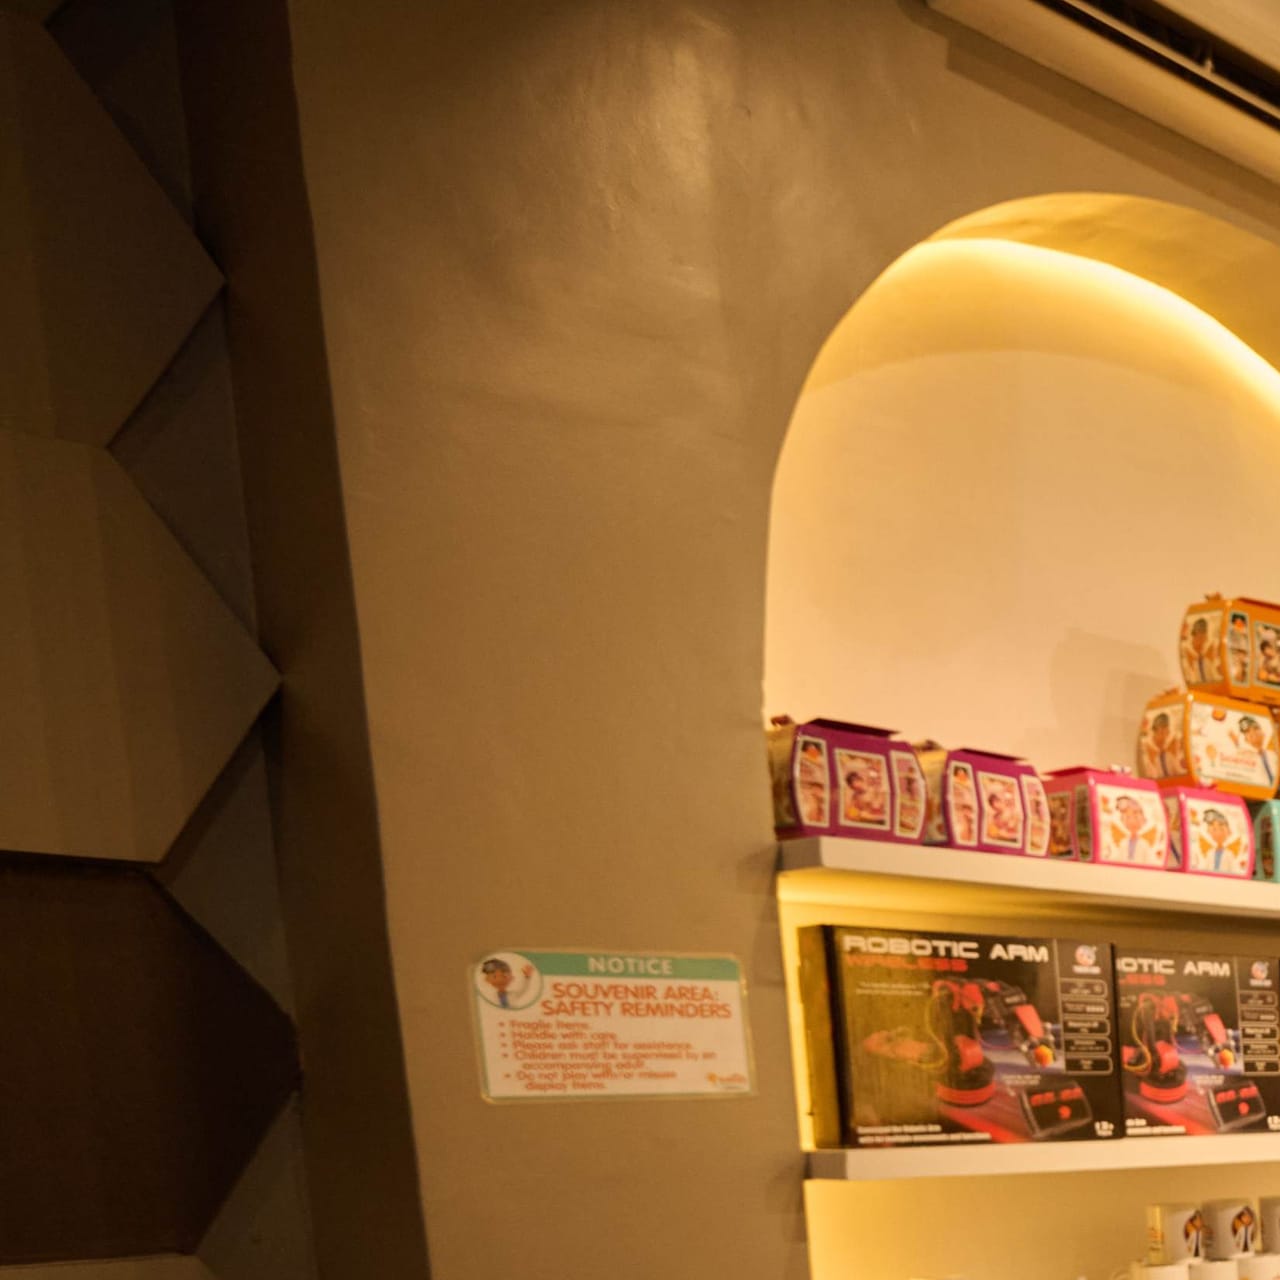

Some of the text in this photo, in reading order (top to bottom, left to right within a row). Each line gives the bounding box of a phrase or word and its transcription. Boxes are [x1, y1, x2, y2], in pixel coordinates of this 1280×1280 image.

[842, 935, 1049, 963] ROBOTIC ARM
[588, 957, 673, 975] NOTICE
[1183, 961, 1231, 977] ARM
[553, 982, 719, 1001] SOUVENIR AREA:
[542, 1001, 732, 1019] SAFETY REMINDERS
